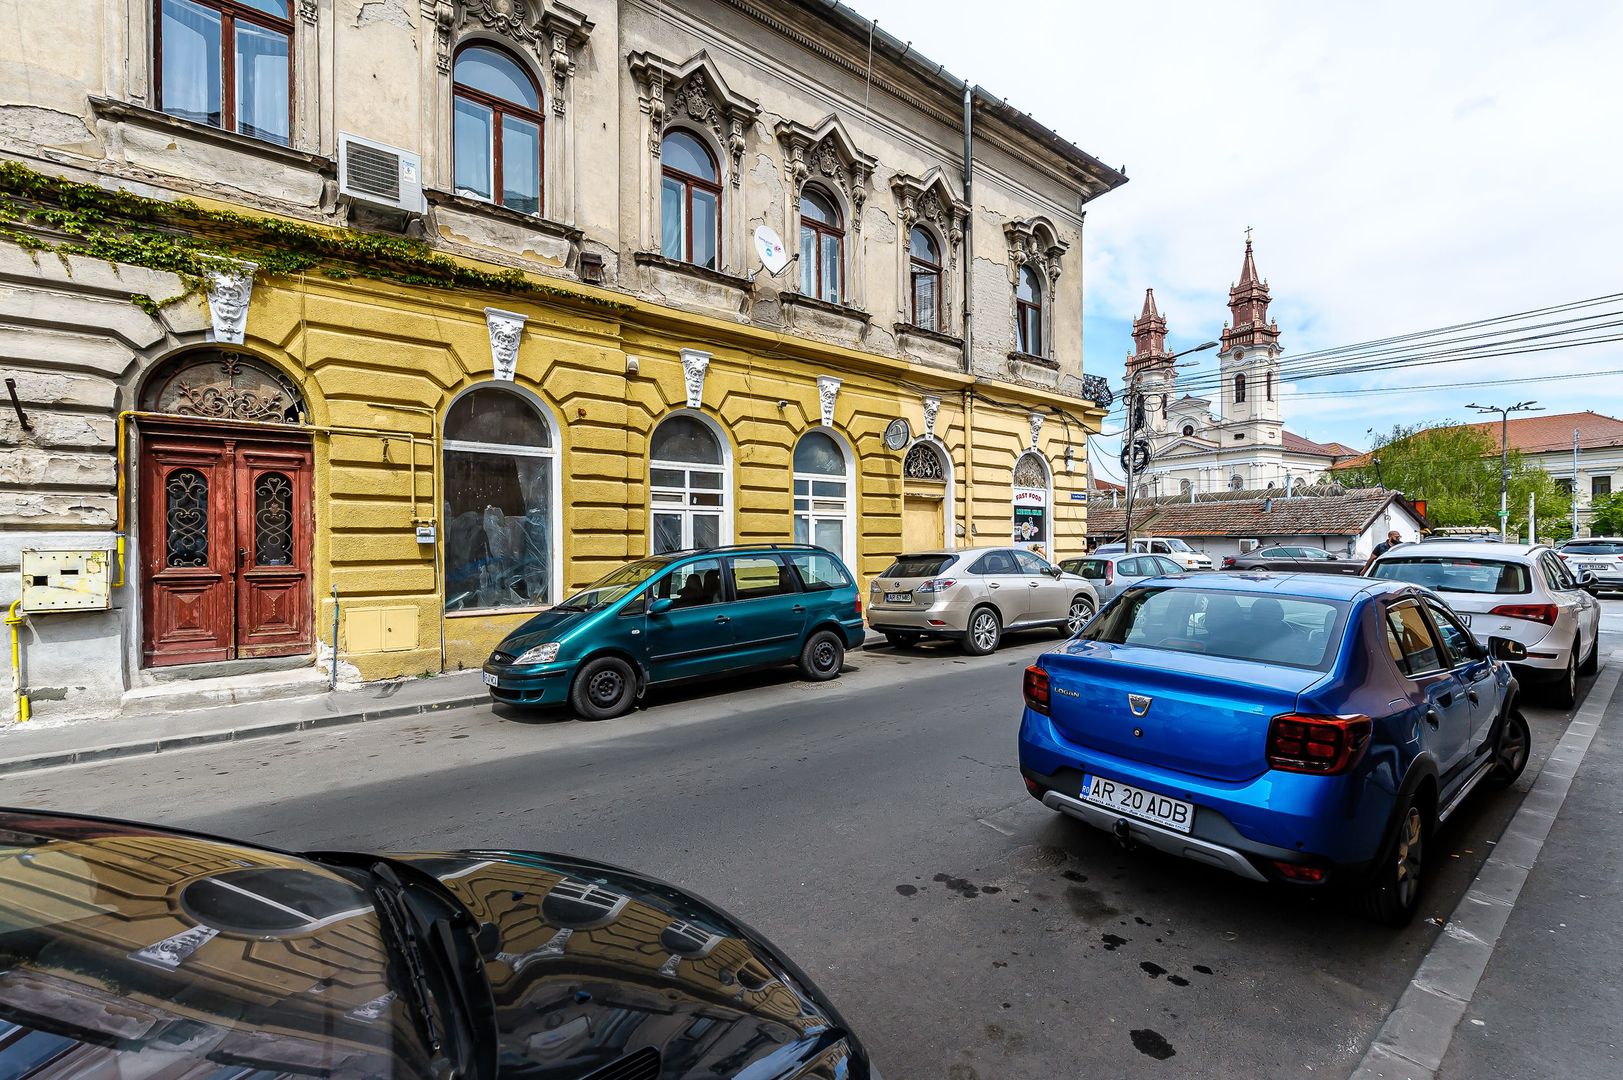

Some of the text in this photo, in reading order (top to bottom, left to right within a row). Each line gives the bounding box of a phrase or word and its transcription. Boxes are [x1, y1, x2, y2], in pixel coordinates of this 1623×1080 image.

[1029, 493, 1041, 501] FOOD
[1091, 779, 1115, 801] AR
[1120, 788, 1143, 809] 20
[1145, 795, 1187, 823] ADB
